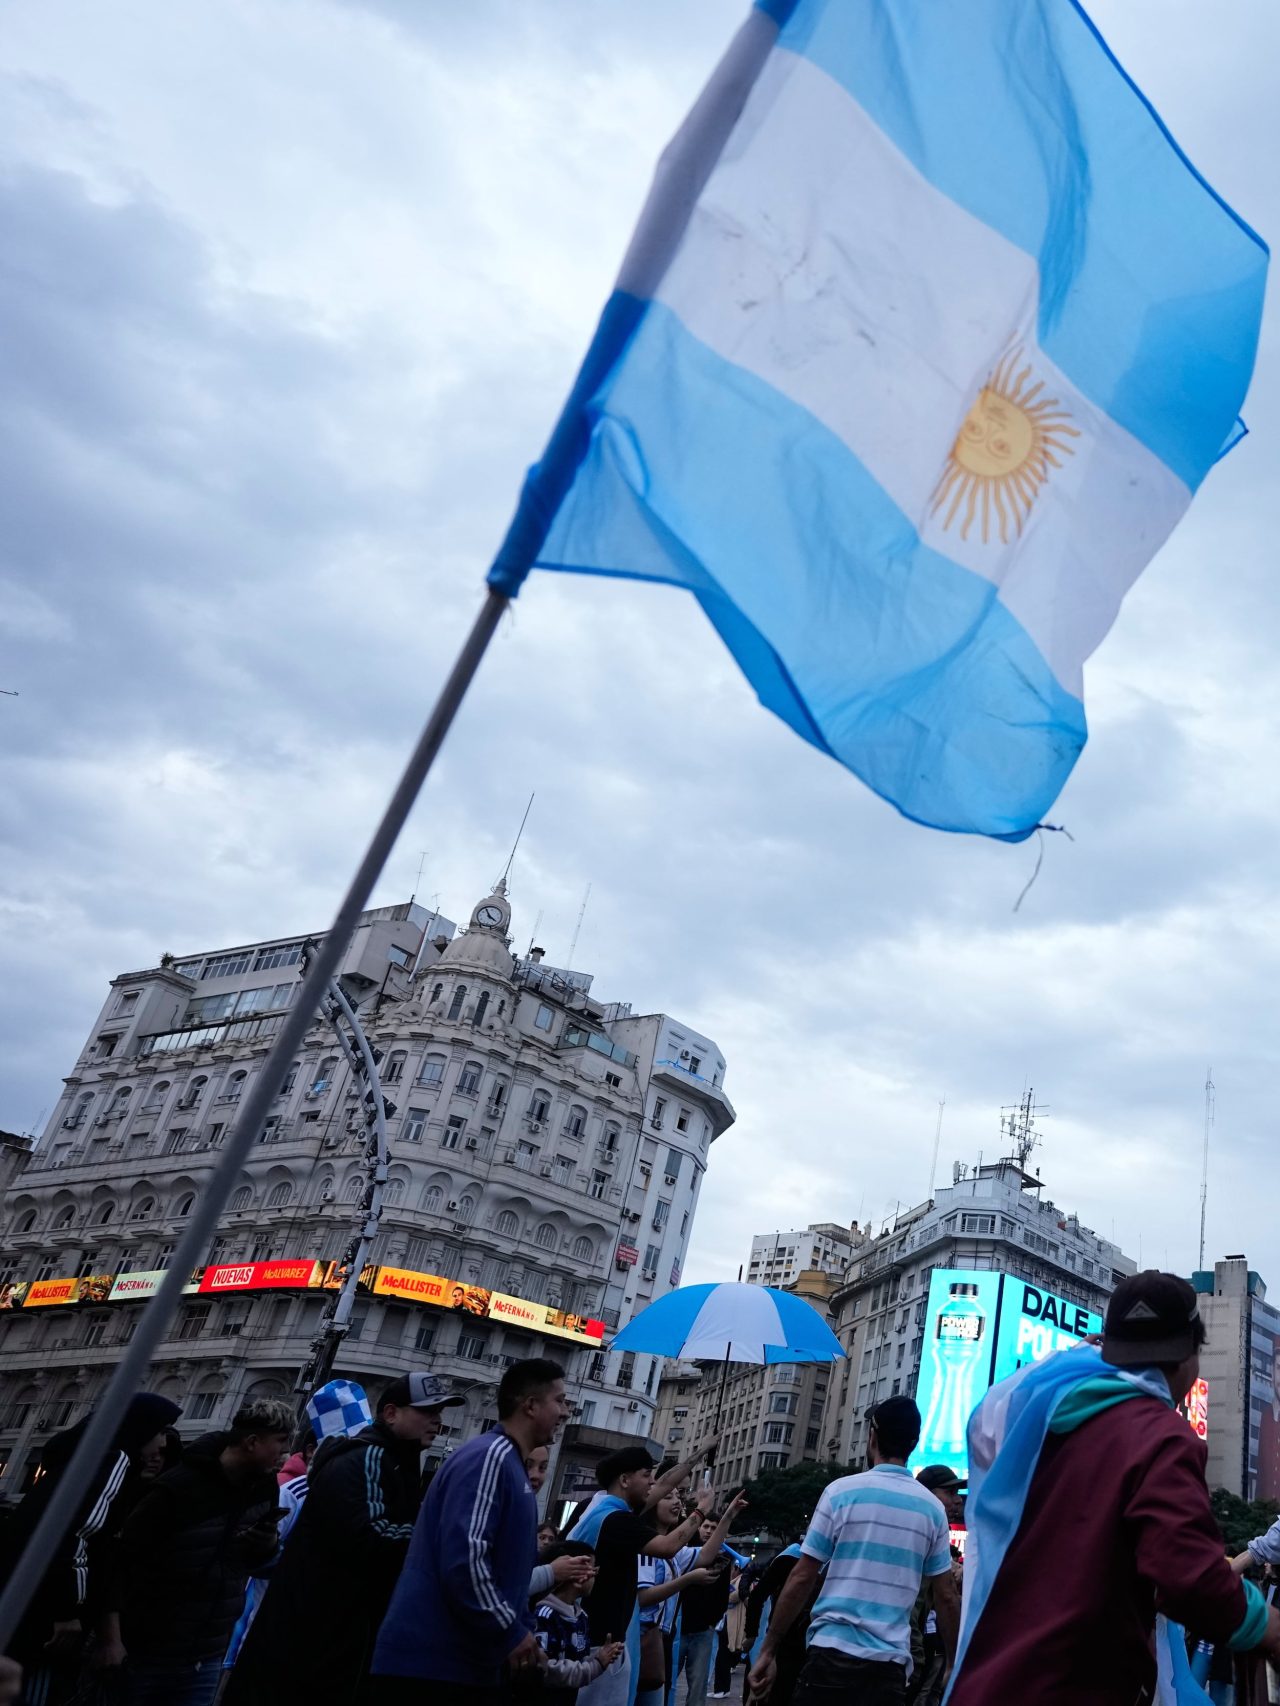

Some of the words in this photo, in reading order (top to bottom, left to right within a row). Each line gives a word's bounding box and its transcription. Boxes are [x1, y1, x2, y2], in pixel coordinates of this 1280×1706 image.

[214, 1268, 252, 1285] NUEVAS
[29, 1285, 72, 1299] McALLISTER
[381, 1274, 442, 1297] McALLISTER
[1022, 1284, 1089, 1338] DALE
[942, 1316, 979, 1329] POWER
